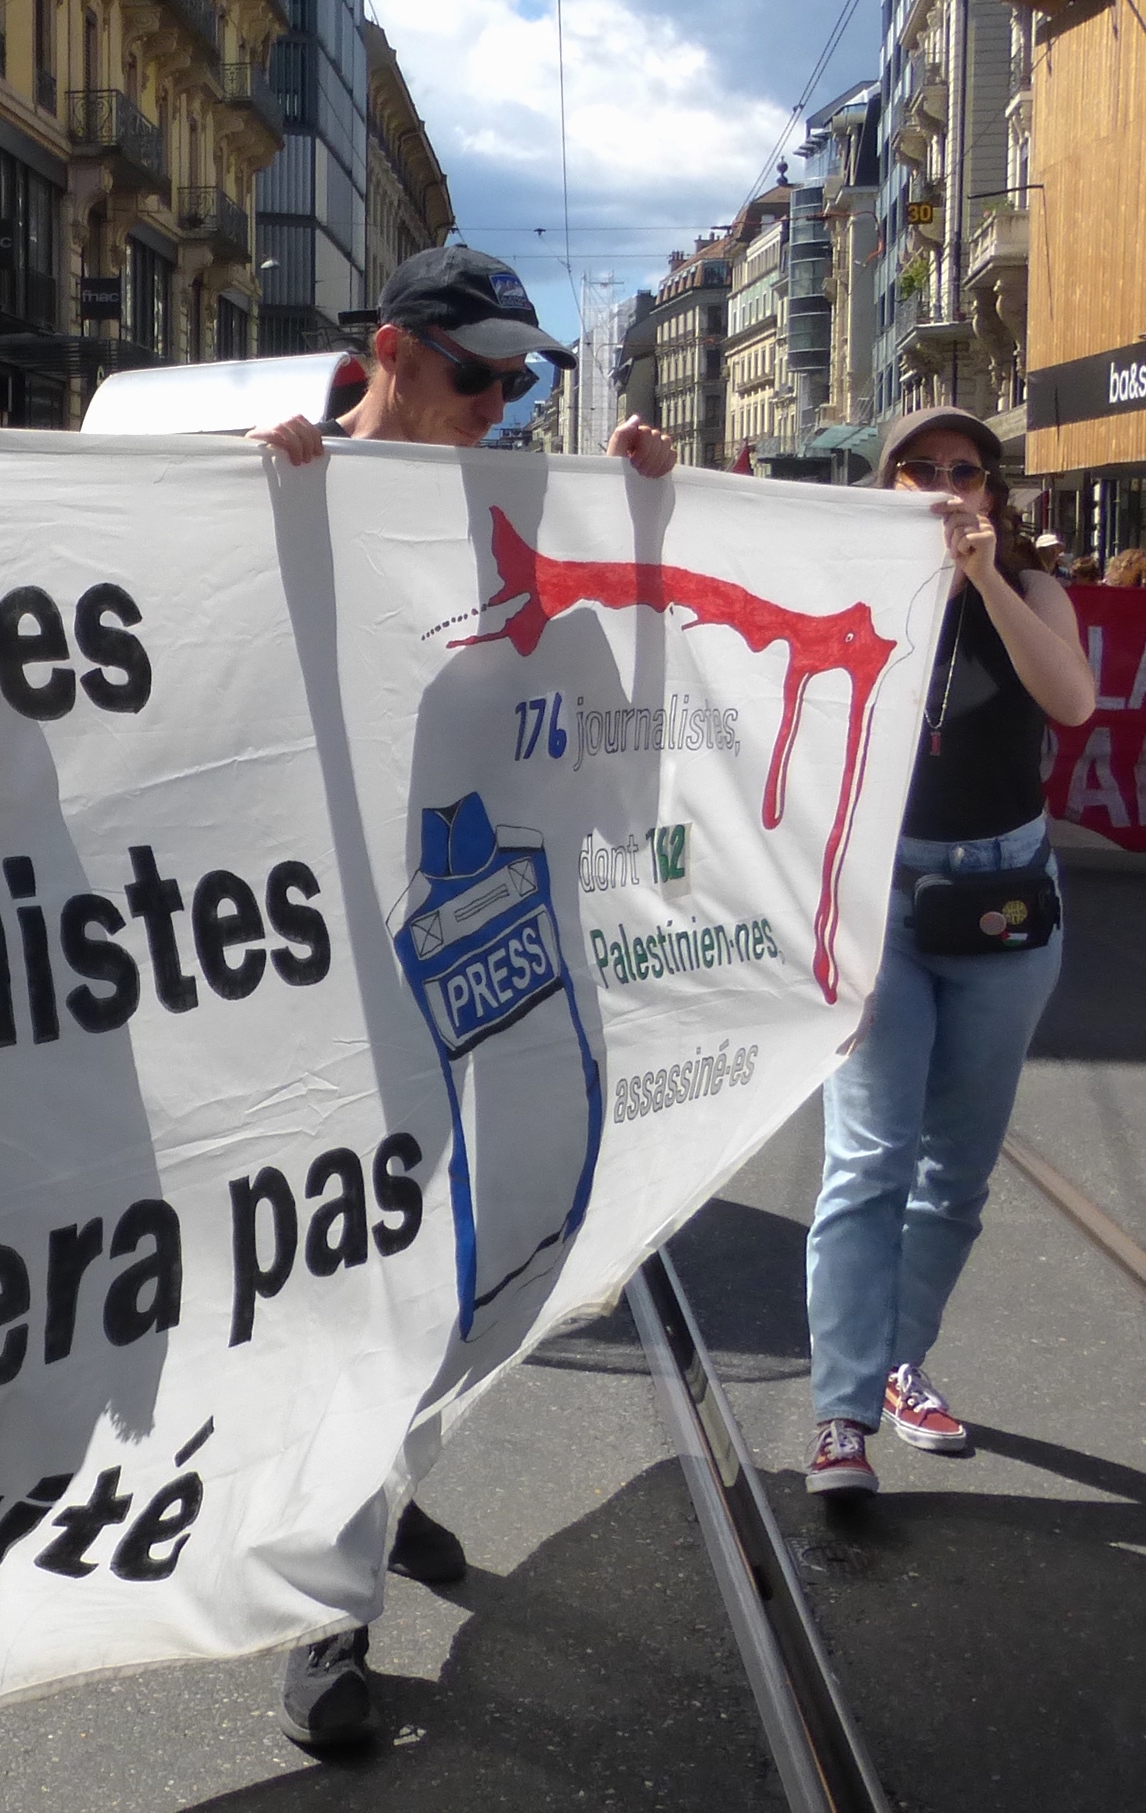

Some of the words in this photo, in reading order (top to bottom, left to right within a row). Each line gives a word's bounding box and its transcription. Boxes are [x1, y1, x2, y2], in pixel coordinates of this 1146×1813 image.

[908, 205, 931, 221] 30
[82, 290, 120, 303] fnac
[514, 692, 568, 762] 176
[573, 694, 742, 772] journalistes,
[579, 833, 640, 893] dont
[447, 927, 547, 1027] PRESS
[229, 1131, 424, 1347] pas
